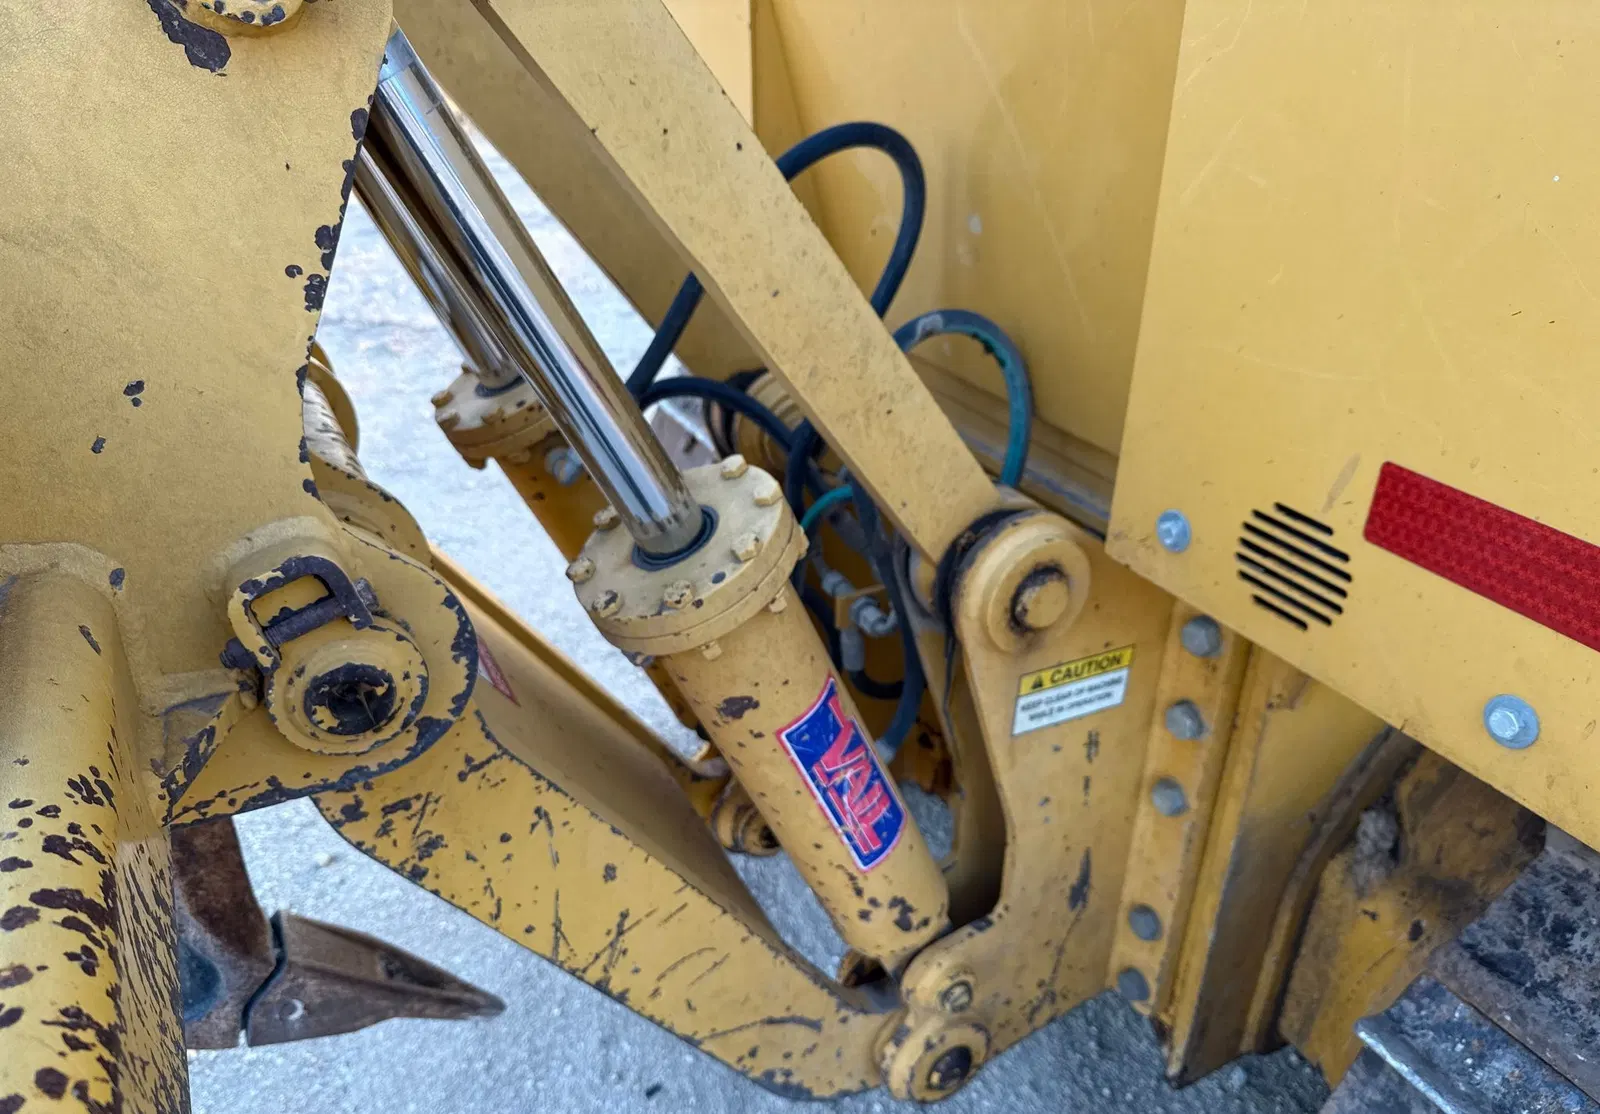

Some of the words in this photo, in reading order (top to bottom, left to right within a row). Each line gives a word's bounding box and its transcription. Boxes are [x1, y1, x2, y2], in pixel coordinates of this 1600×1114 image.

[1050, 655, 1122, 684] CAUTION
[1021, 700, 1042, 712] KEEP
[1044, 691, 1072, 705] CLEAR
[813, 696, 891, 854] VAIL
